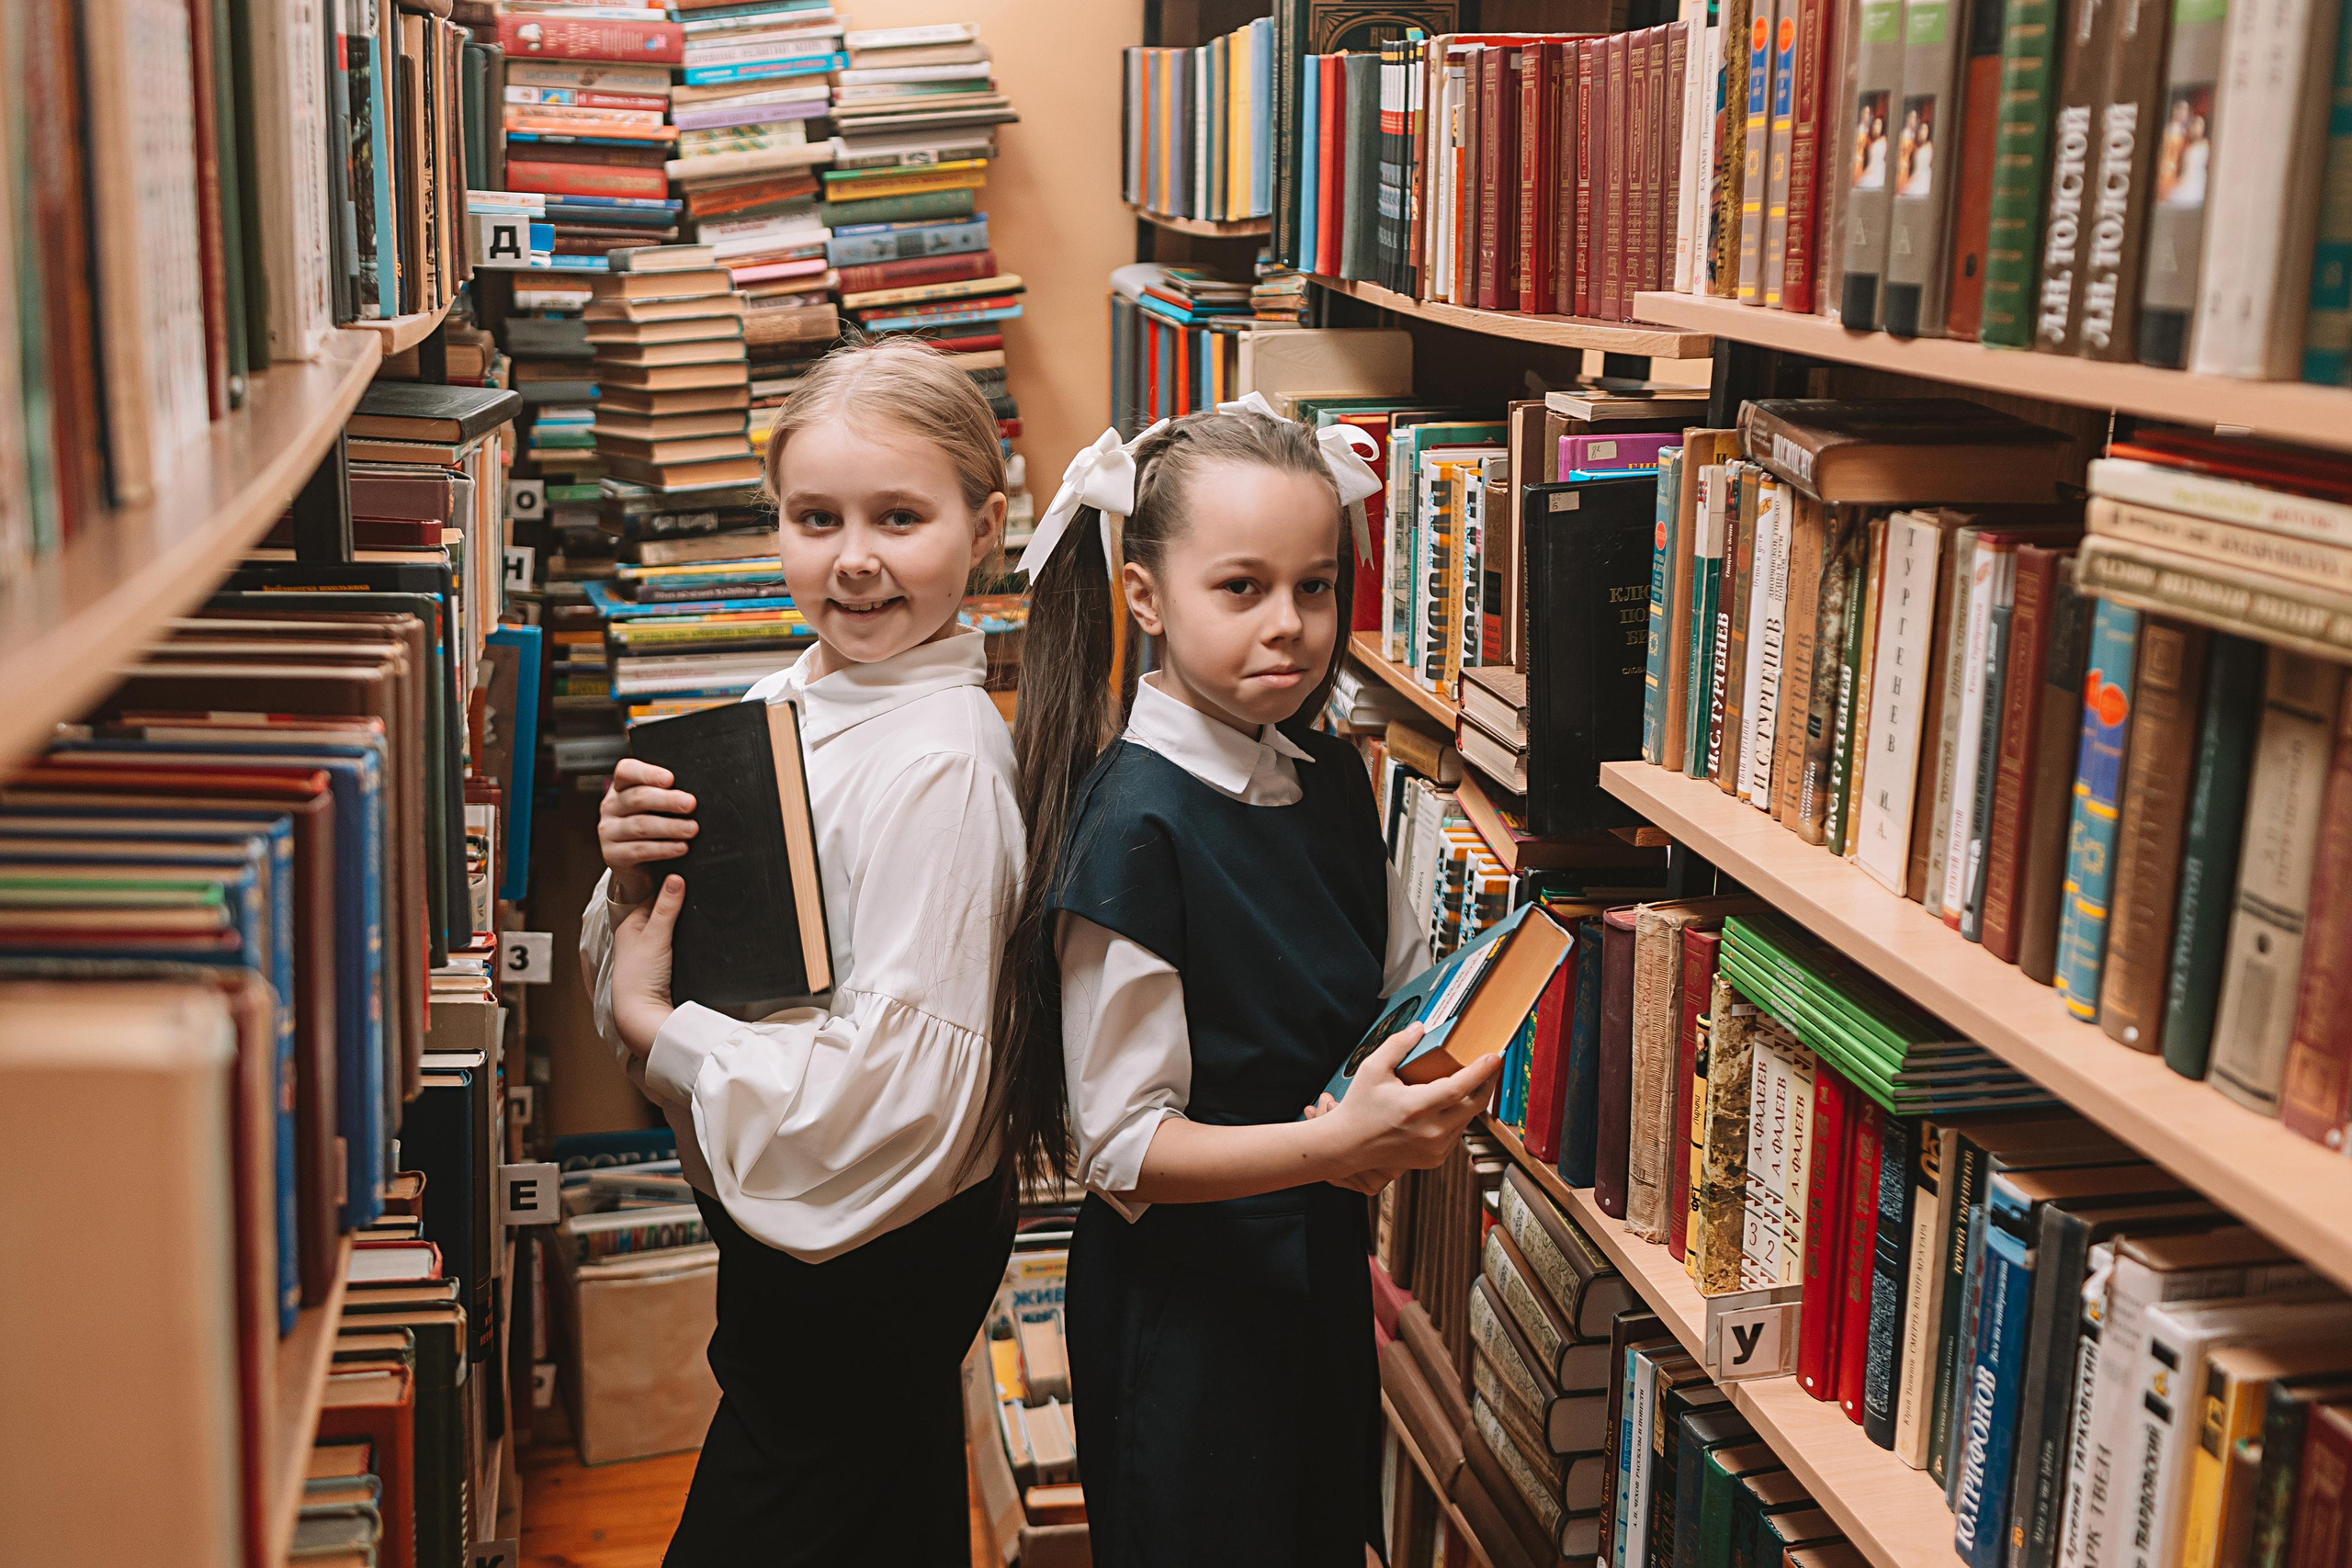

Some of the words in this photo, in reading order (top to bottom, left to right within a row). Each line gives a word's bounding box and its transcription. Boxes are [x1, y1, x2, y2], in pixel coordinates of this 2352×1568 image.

[1699, 149, 1710, 192] КАЗАКИ
[2044, 105, 2091, 265] ТОЛСТОЙ
[2086, 101, 2139, 267] ТОЛСТОЙ
[490, 225, 521, 259] Д
[516, 491, 536, 510] О
[503, 556, 525, 580] Н
[1620, 608, 1650, 624] ПО
[1711, 612, 1729, 724] ТУРГЕНЕВ
[1756, 617, 1781, 743] ТУРГЕНЕВ
[1785, 632, 1813, 757] ТУРГЕНЕВ
[1804, 761, 1816, 826] охотника
[1951, 807, 1964, 853] ТОЛСТОЙ
[1641, 949, 1653, 1008] ФАДЕЕВ
[1692, 1094, 1702, 1125] Лирика
[1753, 1061, 1768, 1138] ФАДЕЕВ
[1771, 1076, 1787, 1155] ФАДЕЕВ
[1753, 1143, 1764, 1160] А.
[1792, 1094, 1805, 1173] ФАДЕЕВ
[1770, 1159, 1781, 1177] А.
[1791, 1178, 1800, 1196] А.
[510, 1180, 537, 1212] Е
[1748, 1222, 1758, 1246] 3
[1764, 1239, 1775, 1264] 2
[1952, 1227, 1967, 1275] ЮРИЙ
[1785, 1260, 1792, 1283] 1
[1731, 1322, 1765, 1365] У
[1902, 1399, 1913, 1426] Юрий
[1909, 1312, 1920, 1354] СМЕРТЬ
[1916, 1224, 1928, 1272] МУХТАРА
[2064, 1482, 2082, 1561] Арсений
[2074, 1341, 2098, 1474] ТАРКОВСКИЙ
[1600, 1472, 1611, 1505] Чехов
[2089, 1441, 2112, 1518] ТВЕН
[2133, 1422, 2163, 1552] ТВАРДОВСКИЙ
